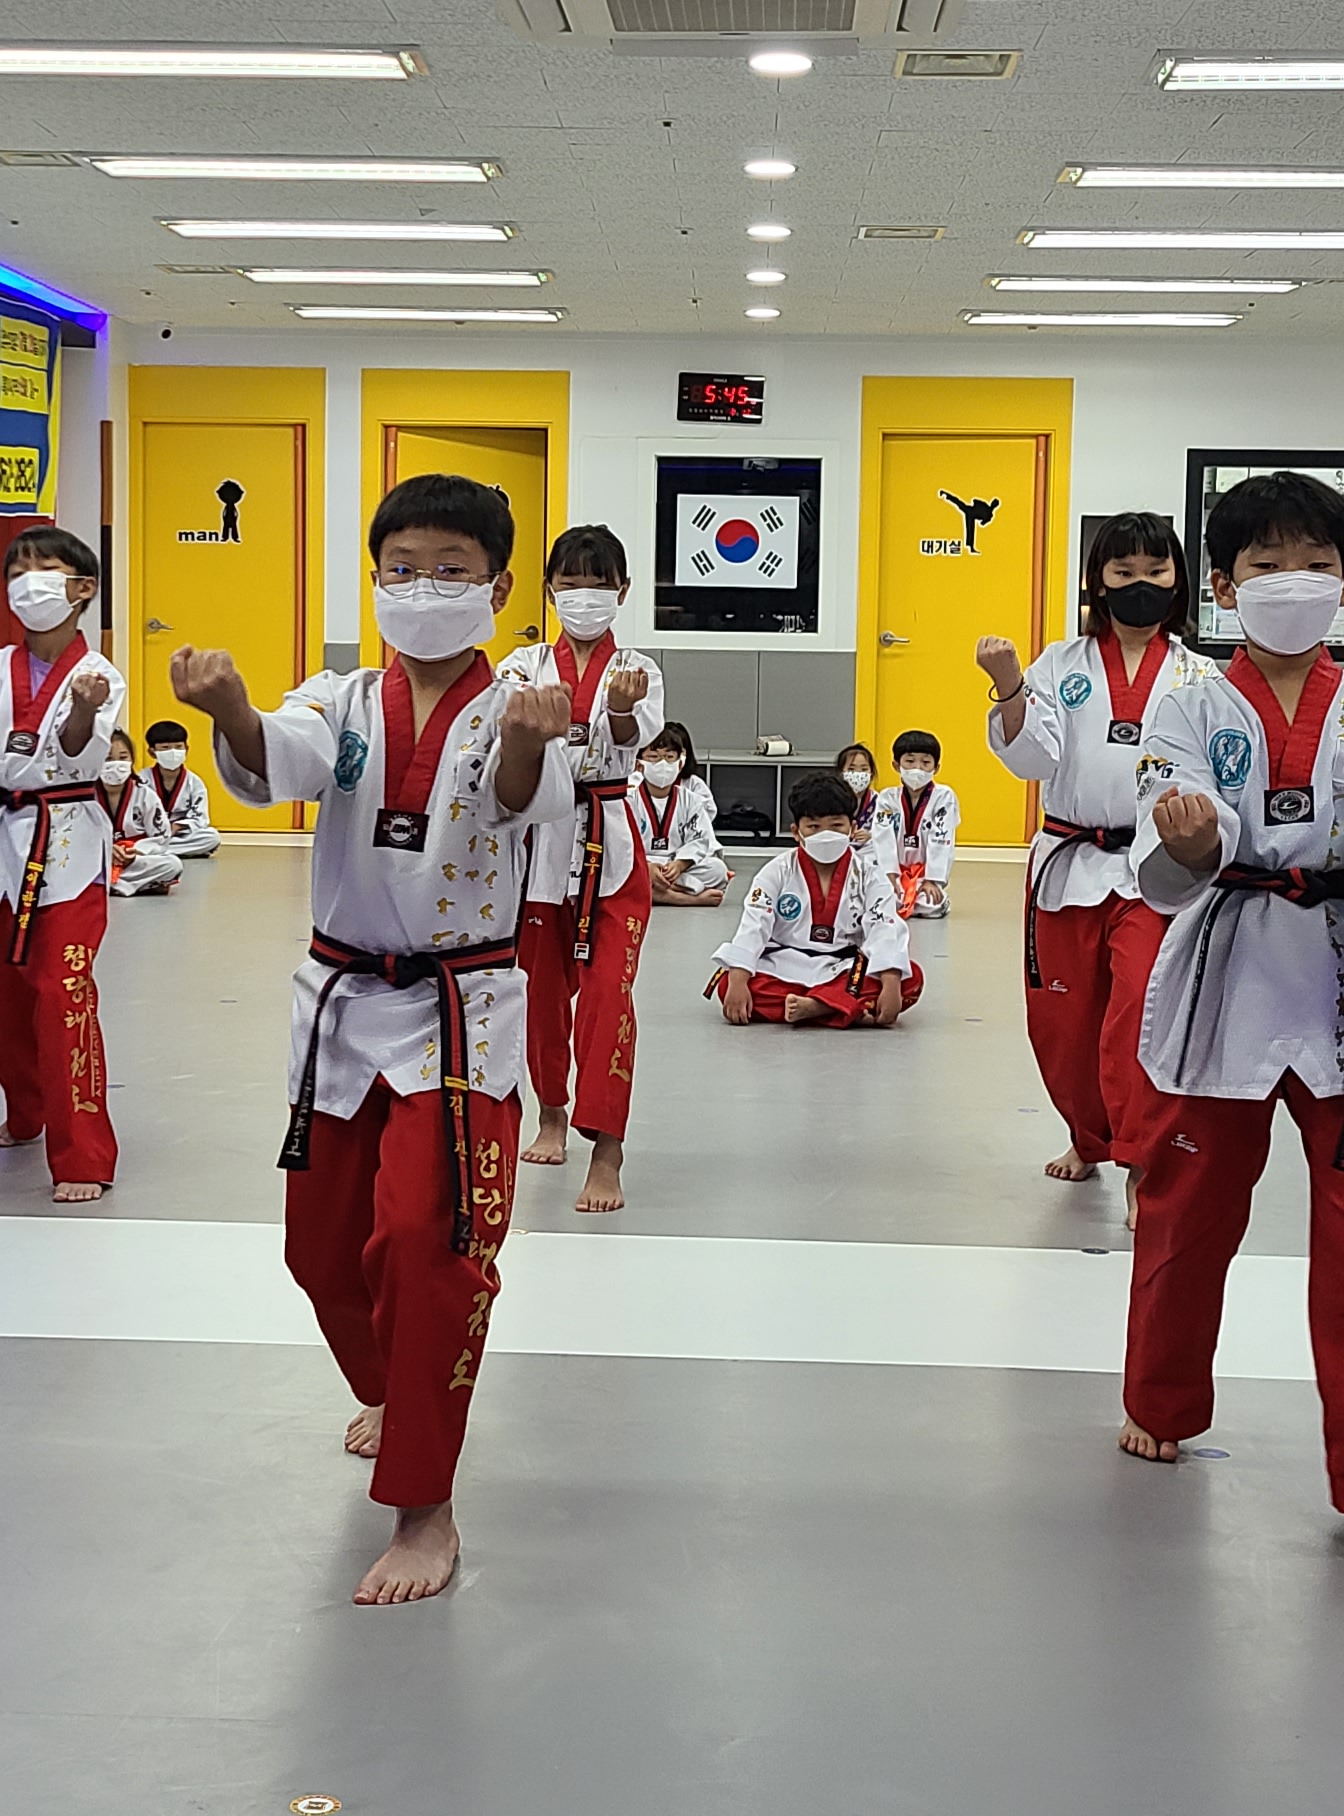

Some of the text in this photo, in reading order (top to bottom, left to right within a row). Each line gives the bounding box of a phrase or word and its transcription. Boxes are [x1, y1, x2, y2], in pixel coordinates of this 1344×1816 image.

[705, 385, 749, 404] 5:45
[178, 531, 219, 541] man
[921, 540, 962, 554] 대기실
